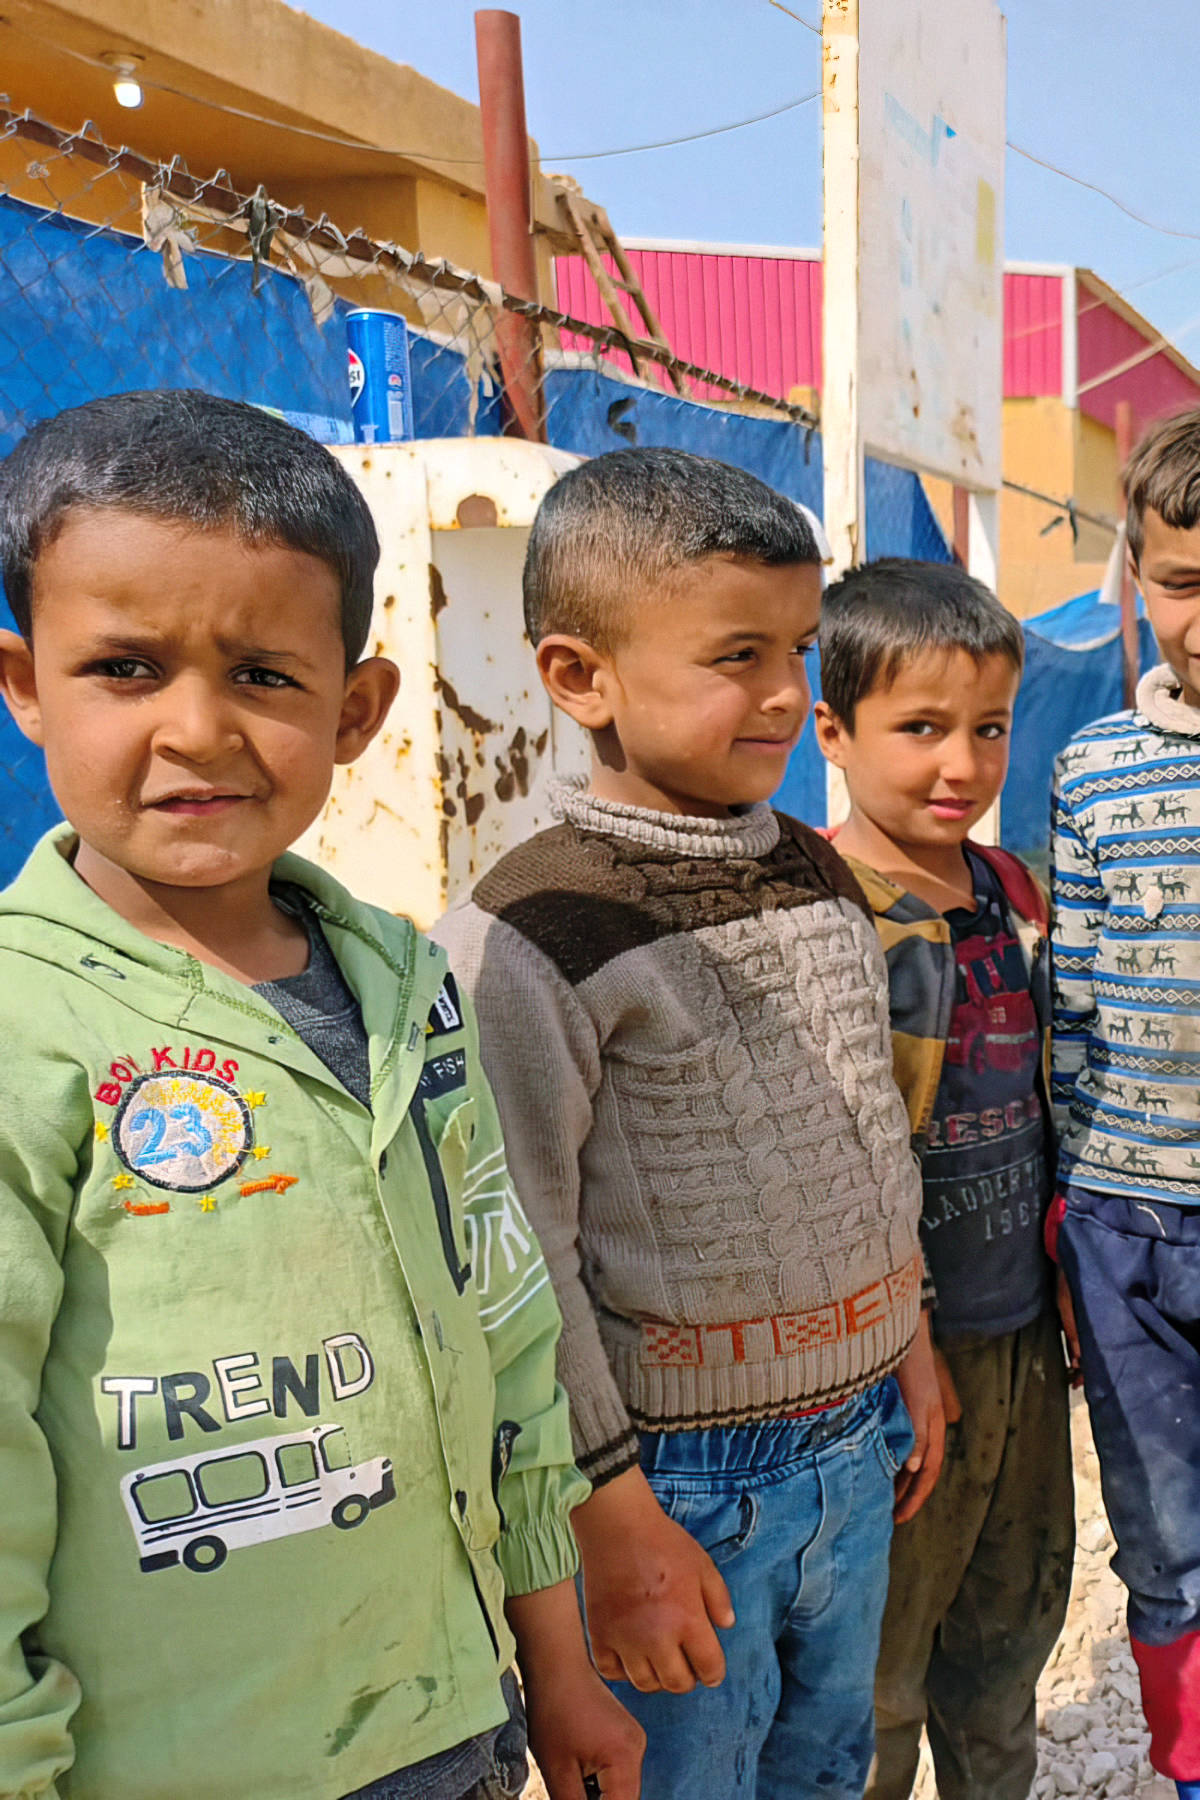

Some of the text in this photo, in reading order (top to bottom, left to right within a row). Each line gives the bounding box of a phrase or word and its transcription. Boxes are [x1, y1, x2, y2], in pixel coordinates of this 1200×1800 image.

[151, 1046, 240, 1084] KIDS
[128, 1103, 214, 1167] 23
[100, 1332, 376, 1451] TREND
